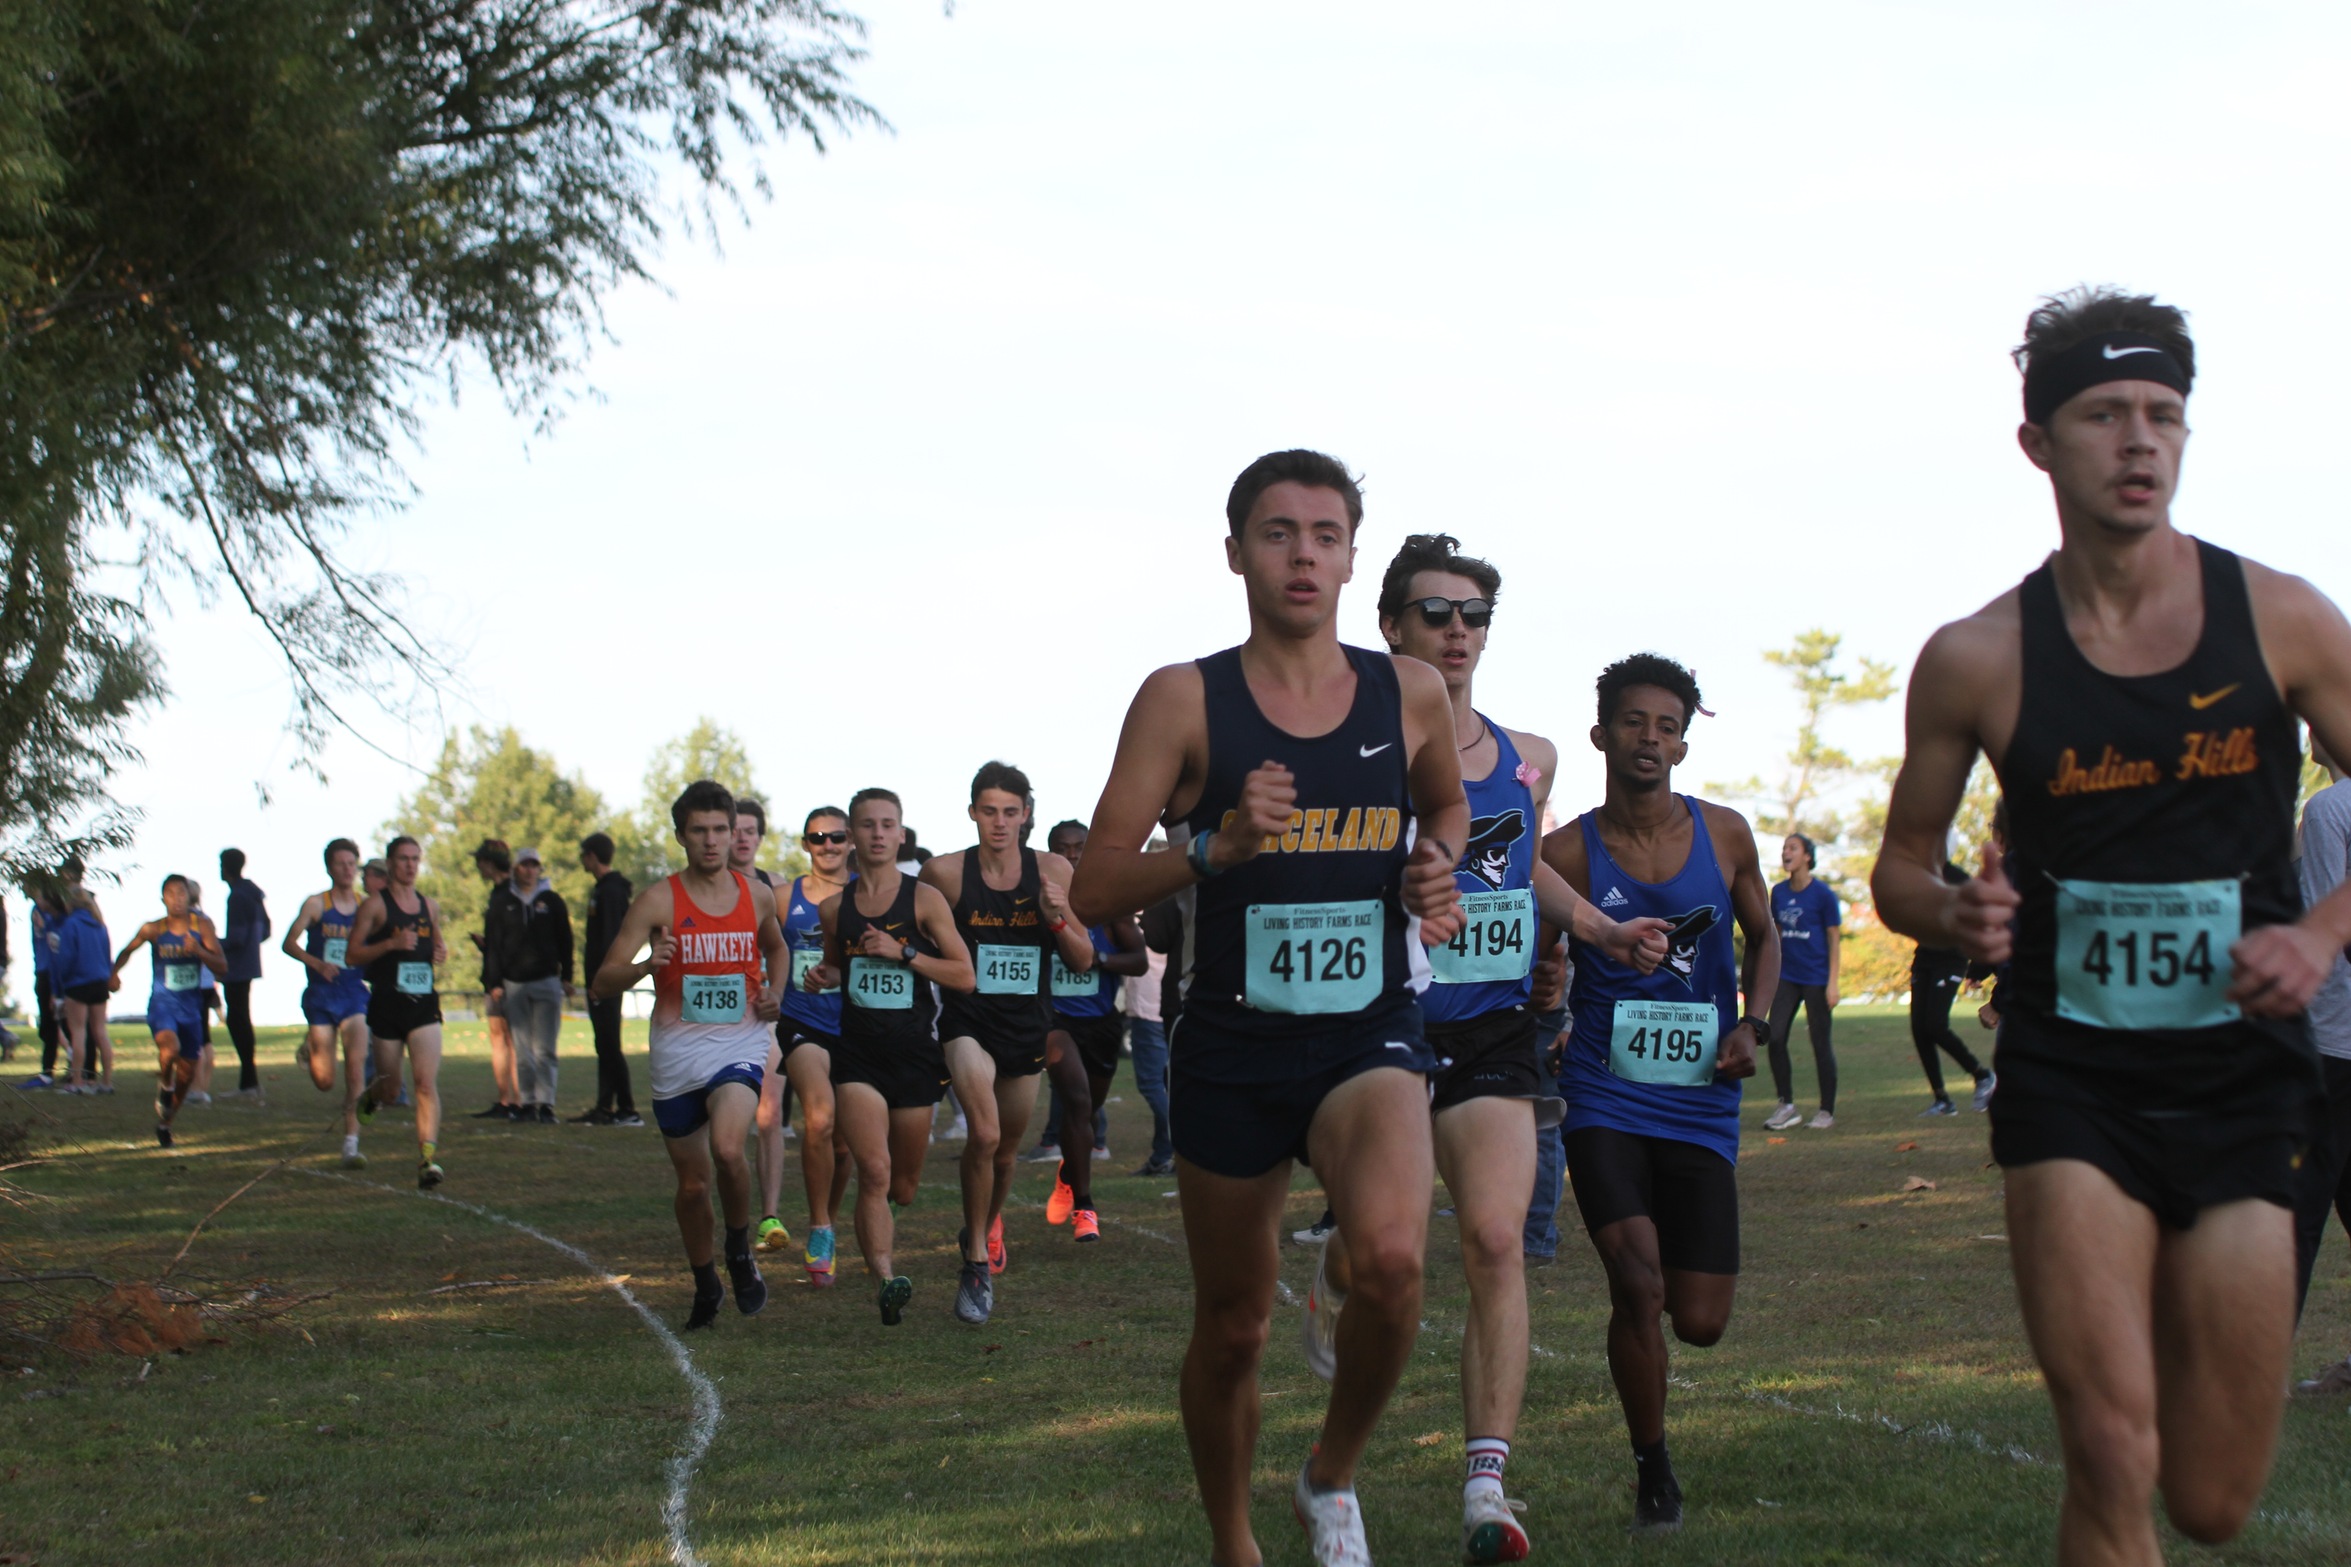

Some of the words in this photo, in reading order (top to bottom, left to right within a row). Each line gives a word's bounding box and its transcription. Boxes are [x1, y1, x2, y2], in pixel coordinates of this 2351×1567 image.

[2047, 745, 2162, 796] Indian
[2174, 726, 2259, 780] Hills
[1220, 807, 1400, 853] ACELAND
[1468, 902, 1491, 914] HISTORY
[1494, 900, 1513, 912] FARMS
[1514, 899, 1526, 911] RACE
[1469, 895, 1508, 903] FitnessSports
[1601, 898, 1629, 908] adidas
[968, 910, 1005, 926] Indian
[1009, 911, 1039, 927] Hills
[1263, 917, 1290, 930] LIVING
[1293, 916, 1324, 930] HISTORY
[1326, 915, 1352, 929] FARMS
[1354, 913, 1372, 926] RACE
[681, 931, 754, 964] HAWKEYE
[1448, 918, 1523, 957] 4194
[1270, 936, 1366, 983] 4126
[2082, 929, 2215, 988] 4154
[987, 961, 1030, 981] 4155
[1055, 968, 1092, 985] 4185
[858, 974, 904, 995] 4153
[692, 990, 738, 1010] 4138
[1627, 1009, 1647, 1020] LIVING
[1648, 1010, 1672, 1022] HISTORY
[1674, 1012, 1693, 1023] FARMS
[1695, 1012, 1709, 1024] RACE
[1627, 1027, 1703, 1063] 4195
